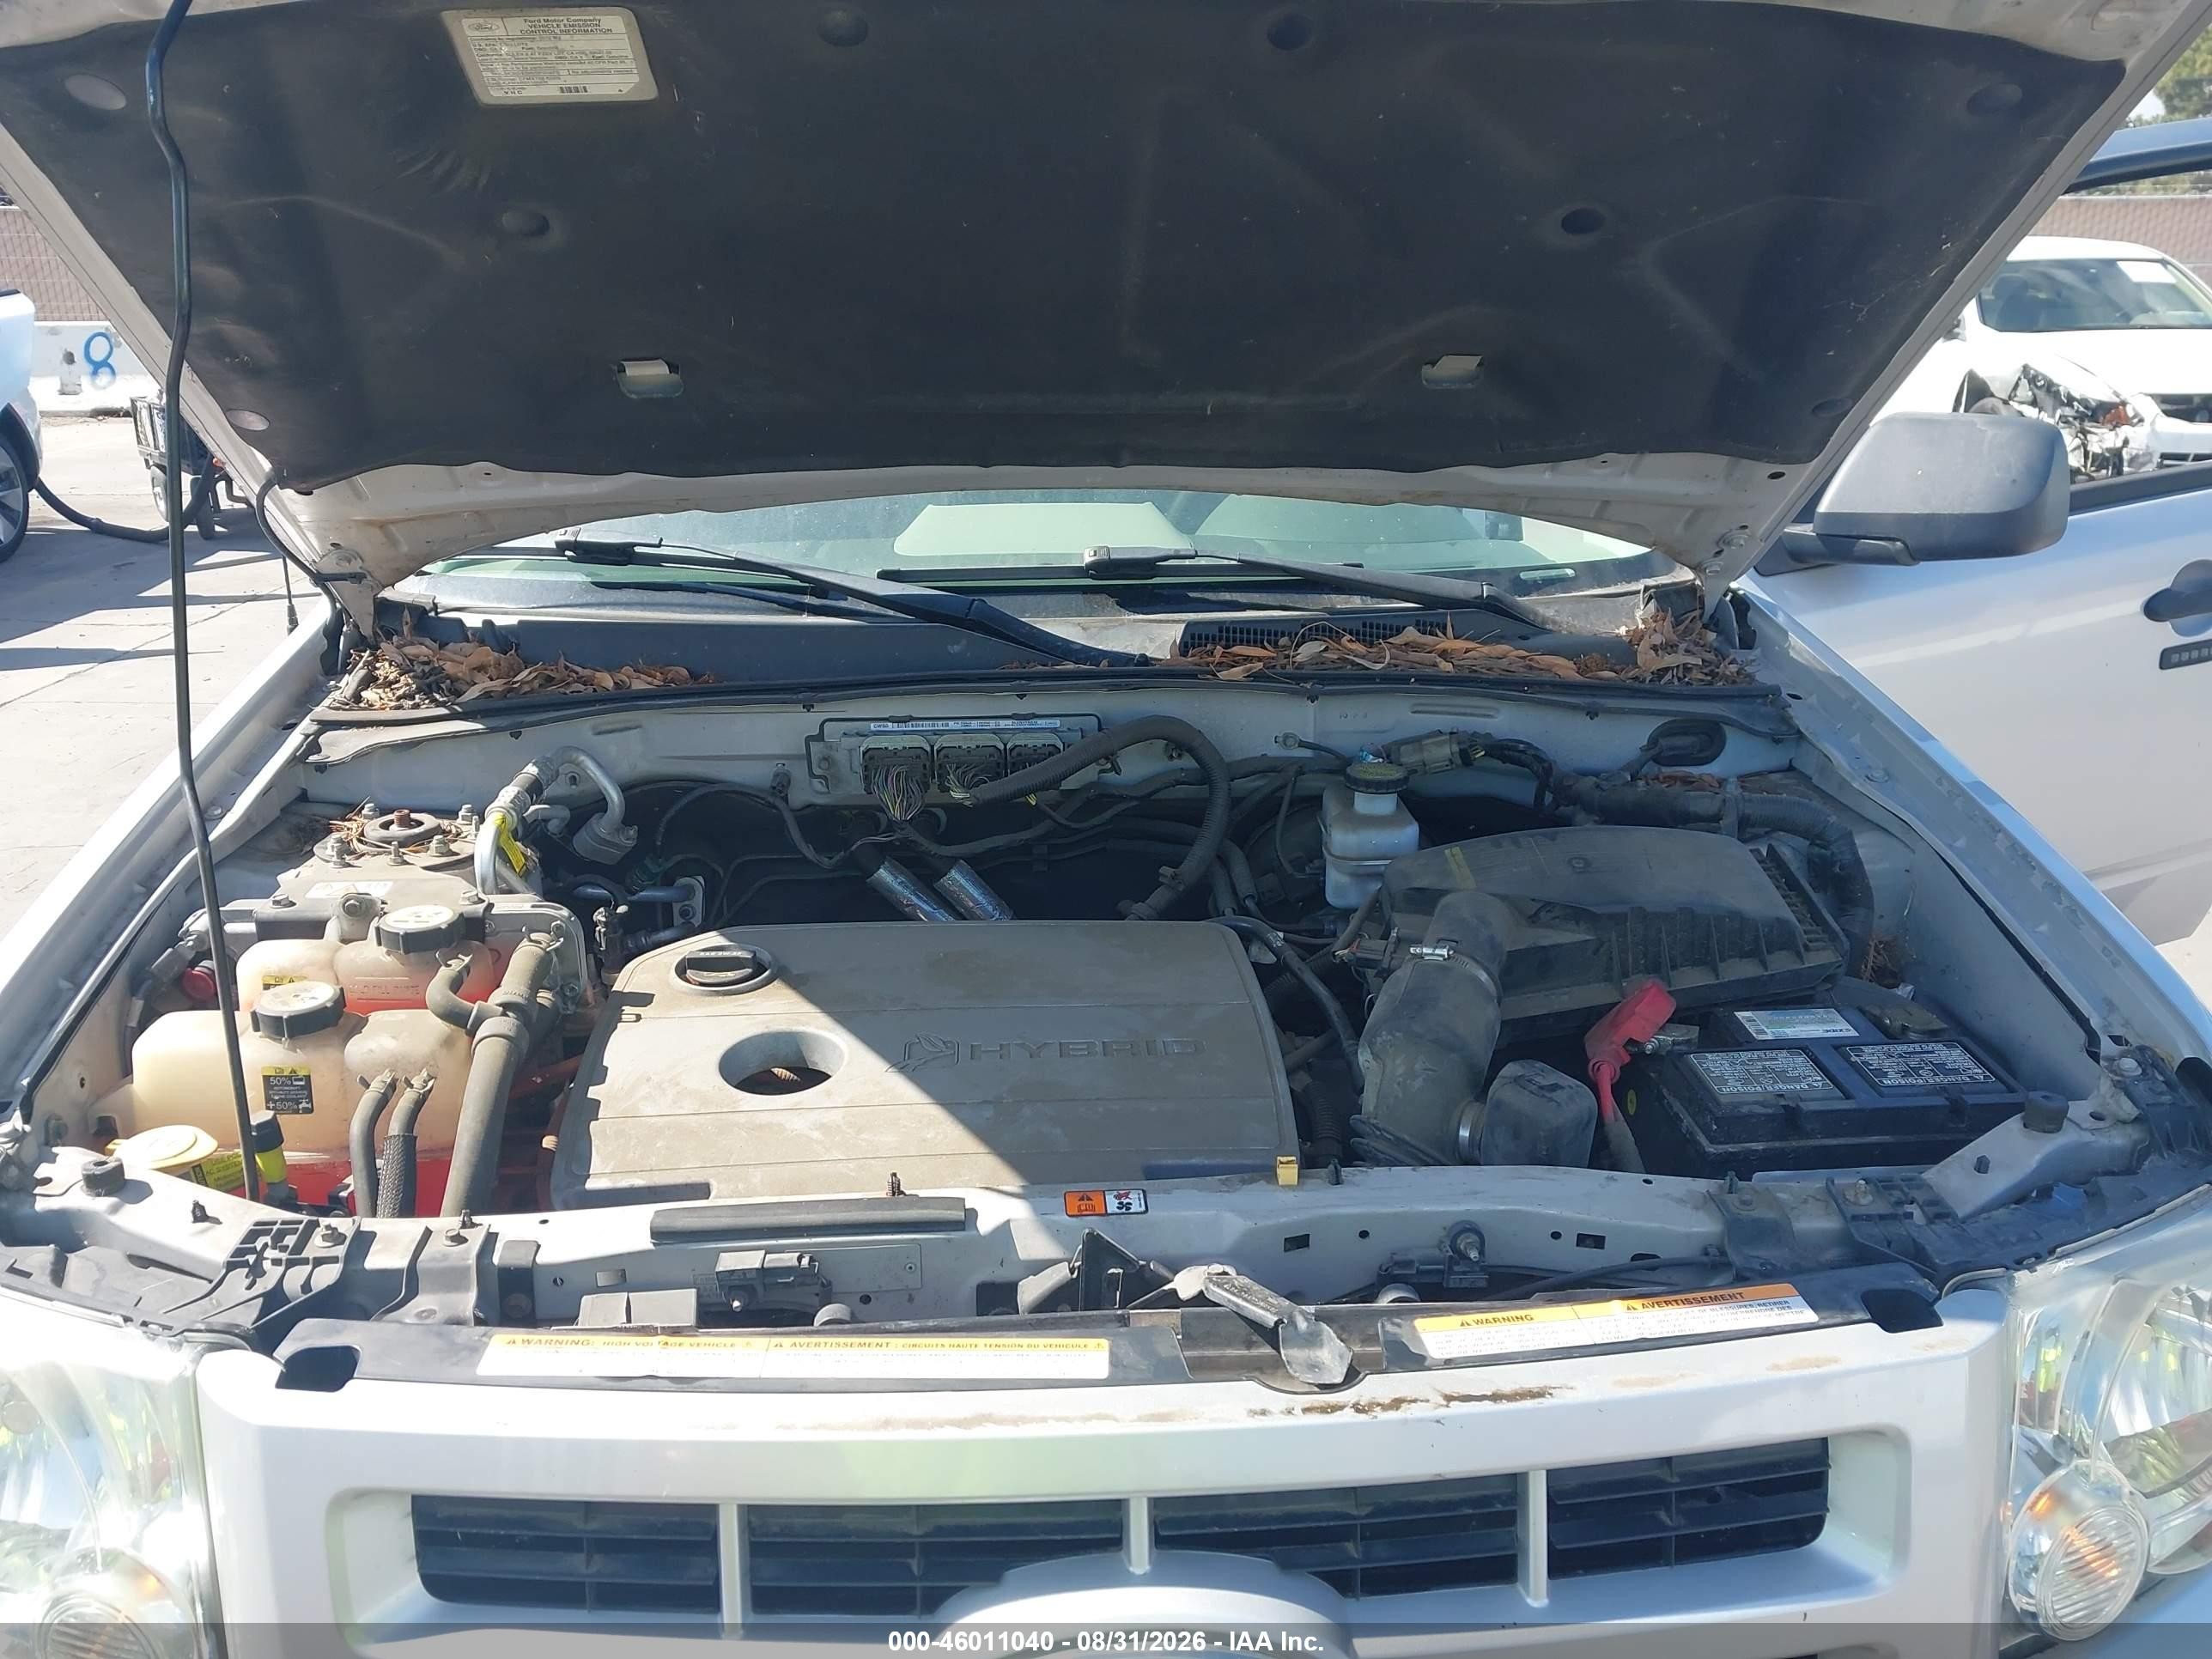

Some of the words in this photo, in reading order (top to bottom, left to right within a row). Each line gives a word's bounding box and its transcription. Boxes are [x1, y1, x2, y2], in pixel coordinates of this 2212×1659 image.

[83, 331, 116, 391] 8
[969, 1038, 1202, 1060] HYBRID
[270, 1077, 292, 1085] 50%
[1641, 1291, 1747, 1310] AVERTISSEMENT
[1472, 1314, 1534, 1326] WARNING
